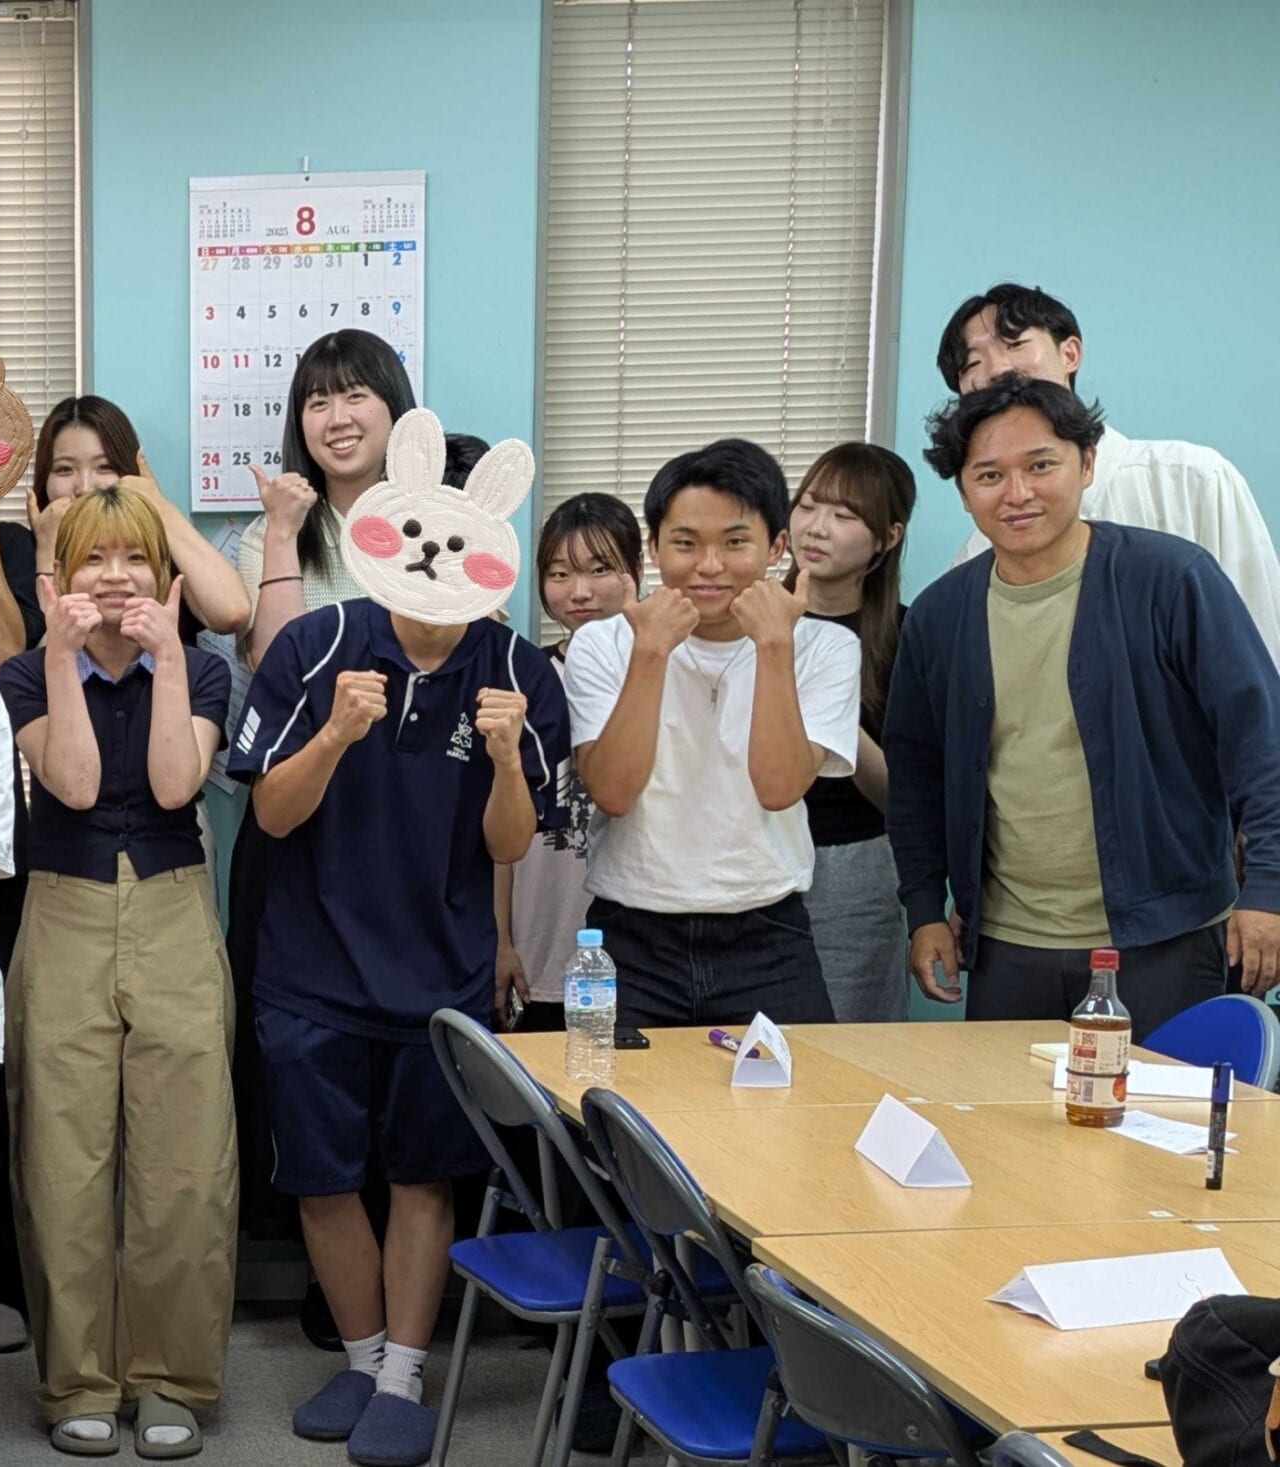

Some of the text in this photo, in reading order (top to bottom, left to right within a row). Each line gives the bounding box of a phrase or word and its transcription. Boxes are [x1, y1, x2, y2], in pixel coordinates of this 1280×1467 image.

[265, 206, 350, 237] 2025 8 AUG
[201, 252, 401, 271] 27 28 29 30 31 1 2
[205, 301, 401, 320] 3 4 5 6 7 8 9
[202, 355, 220, 369] 10
[234, 355, 249, 368] 11
[264, 354, 282, 368] 12
[203, 403, 282, 417] 17 18 19
[202, 452, 282, 466] 24 25 26
[202, 477, 219, 490] 31
